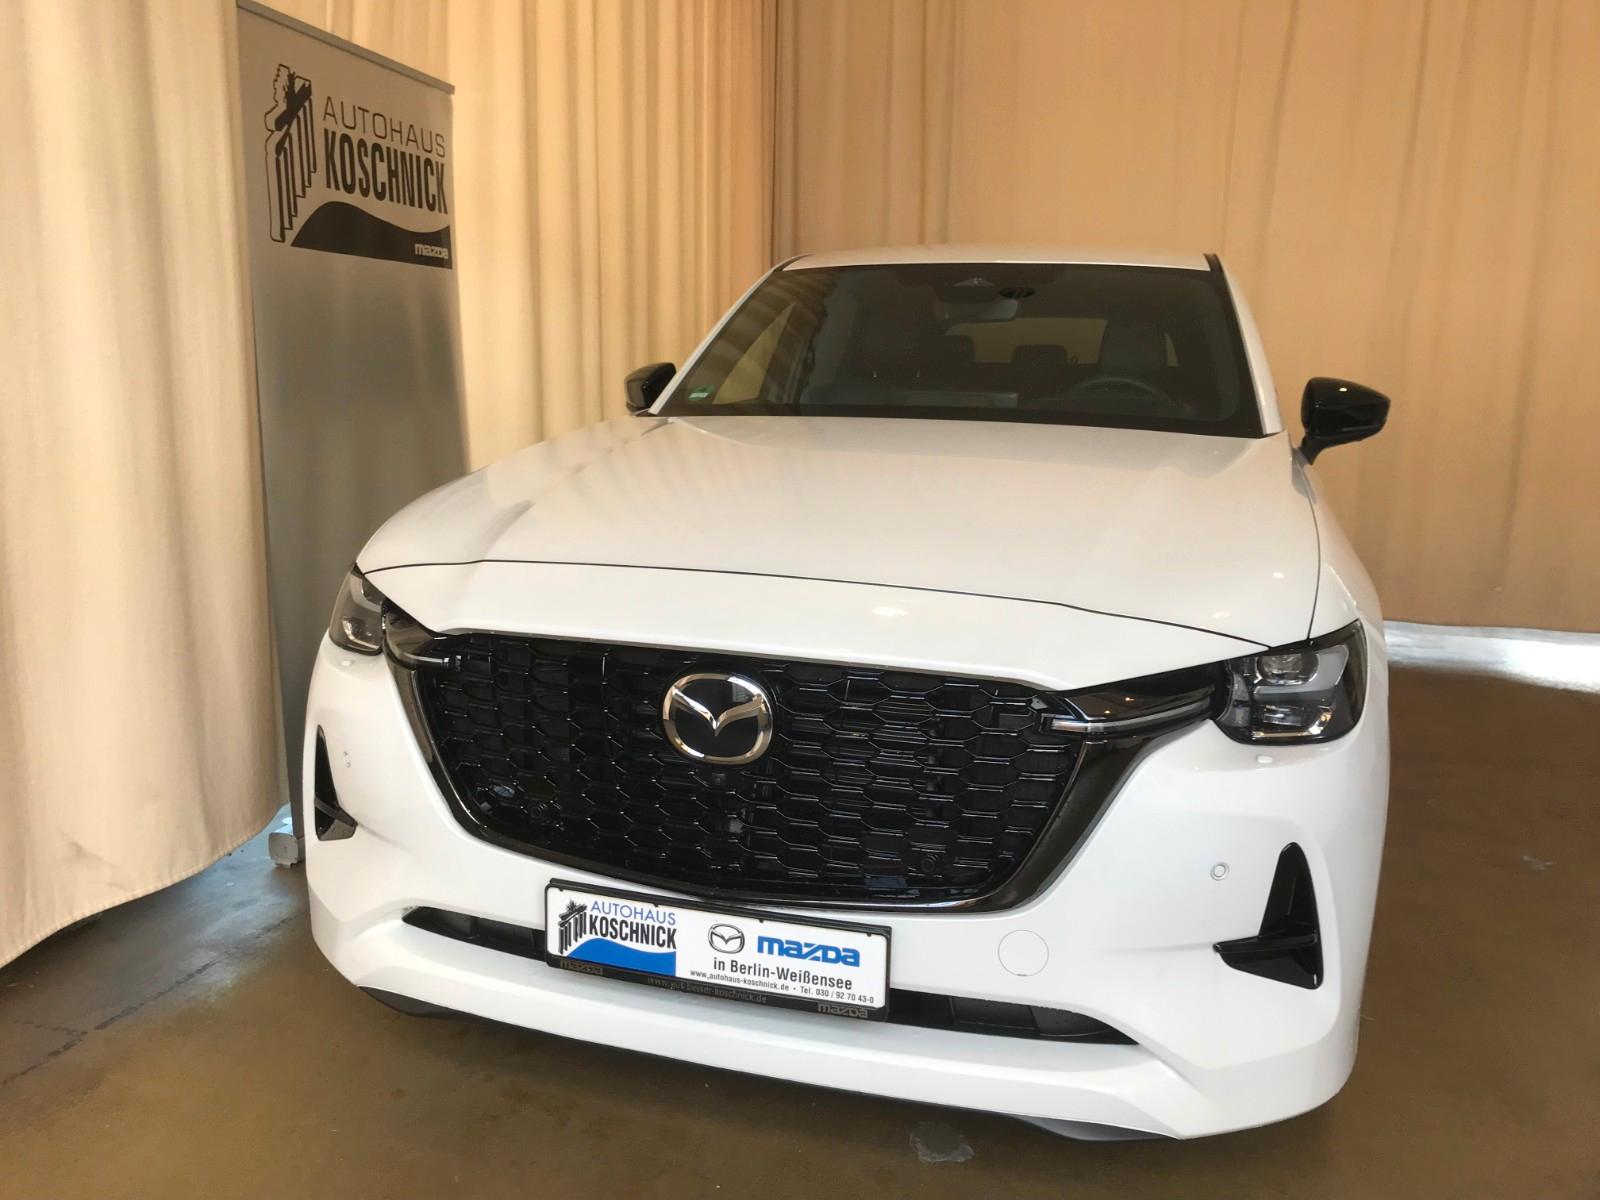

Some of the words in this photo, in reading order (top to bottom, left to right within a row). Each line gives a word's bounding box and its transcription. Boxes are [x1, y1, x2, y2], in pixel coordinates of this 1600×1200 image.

[323, 96, 446, 158] AUTOHAUS
[324, 128, 448, 214] KOSCHNICK
[590, 900, 676, 926] AUTOHAUS
[589, 914, 677, 949] KOSCHNICK
[757, 935, 860, 967] mazda
[690, 970, 790, 991] www.autohaus-koschnick.de
[800, 986, 814, 995] Tel.
[816, 988, 829, 997] 030
[836, 991, 845, 1000] 92
[847, 992, 856, 1001] 70
[858, 994, 874, 1004] 43-0
[713, 957, 726, 972] in
[730, 959, 853, 990] Berlin-Weißensee
